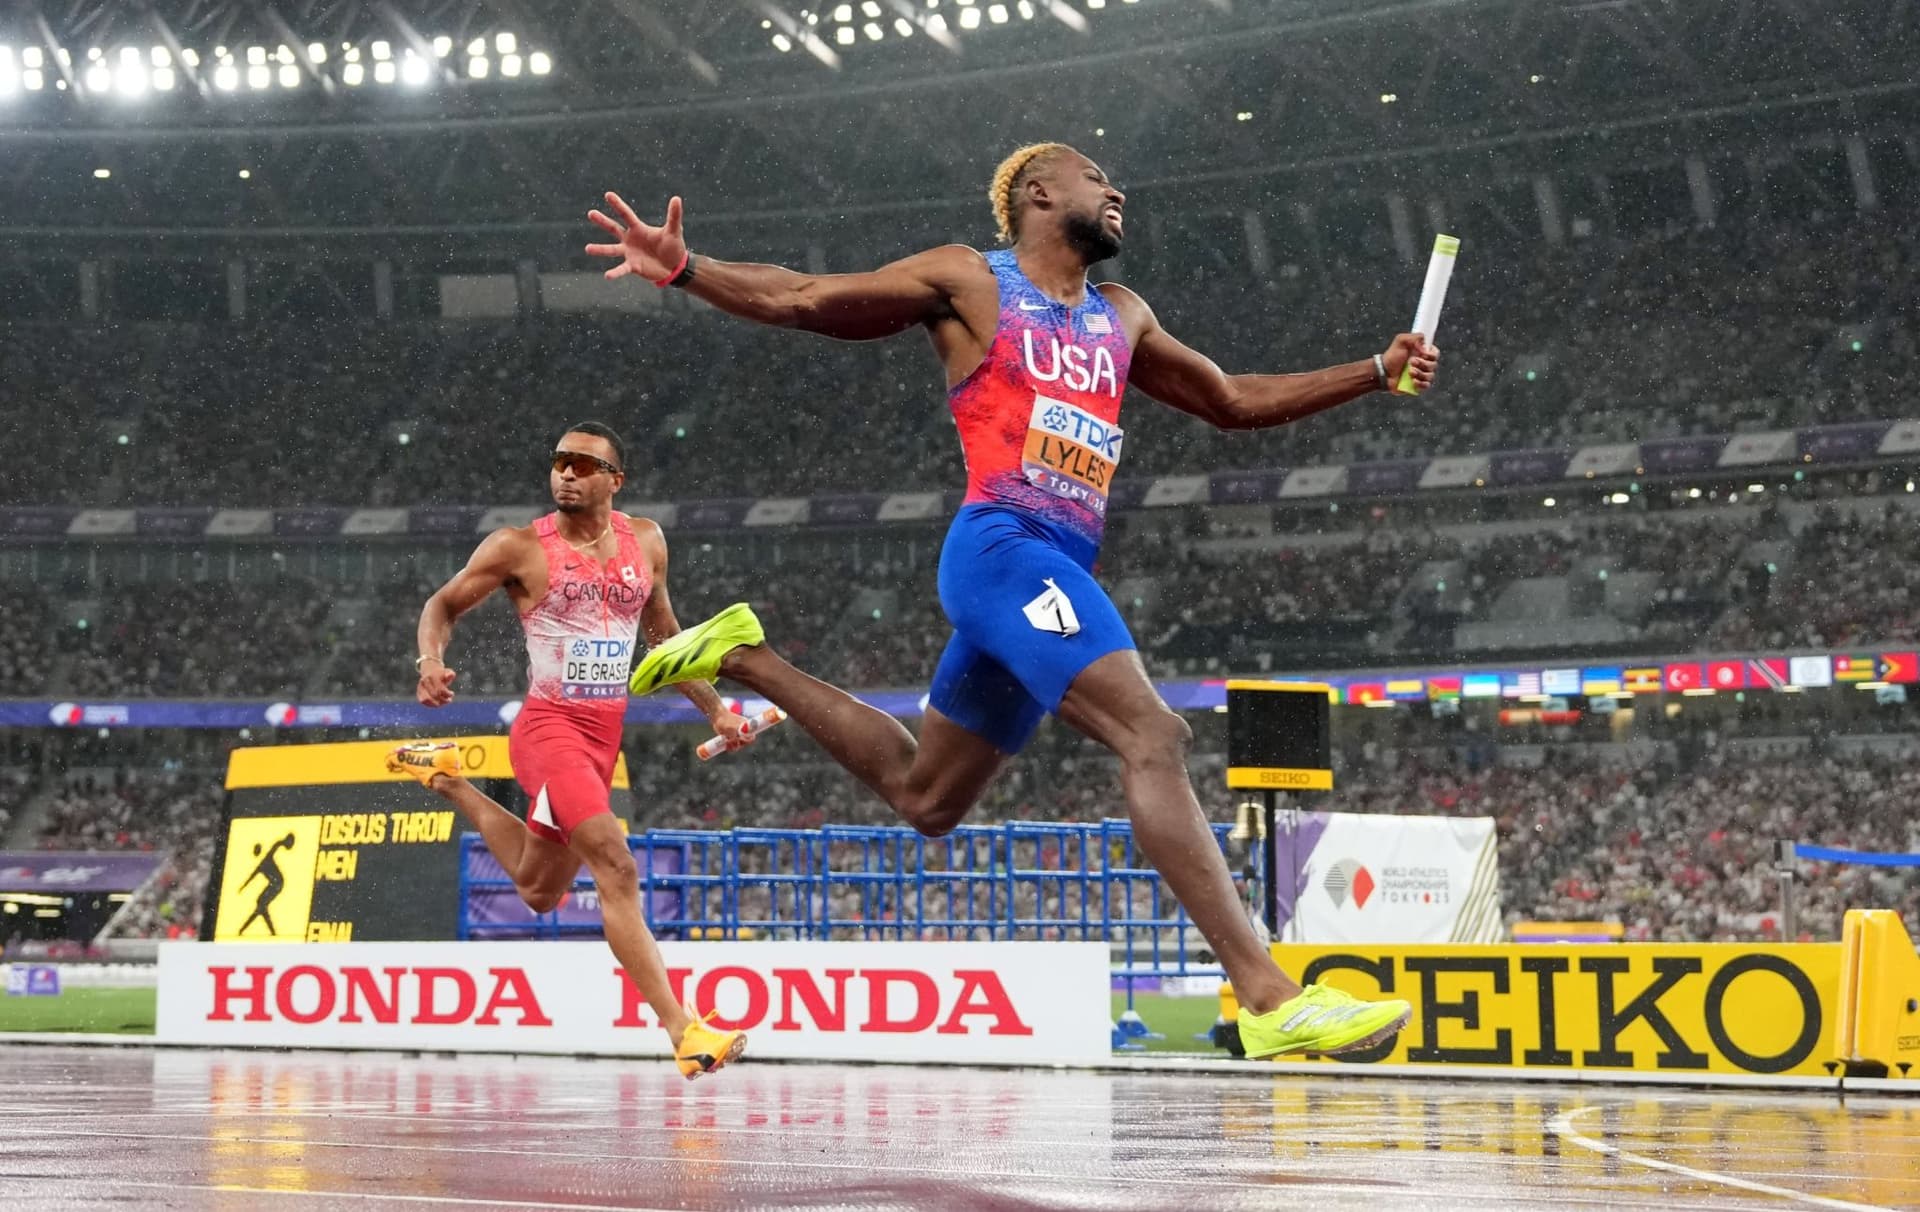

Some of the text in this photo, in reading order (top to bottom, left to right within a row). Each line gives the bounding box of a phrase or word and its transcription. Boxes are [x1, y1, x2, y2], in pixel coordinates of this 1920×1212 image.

[1023, 329, 1117, 398] USA
[1070, 410, 1123, 459] TDK
[1041, 436, 1106, 488] LYLES
[563, 582, 644, 604] CANADA
[590, 640, 631, 657] TDK
[567, 661, 587, 680] DE
[1260, 772, 1311, 785] SEIKO
[320, 811, 455, 845] DISCUS THROW
[315, 850, 358, 880] MEN
[206, 964, 553, 1027] HONDA
[613, 965, 1034, 1037] HONDA
